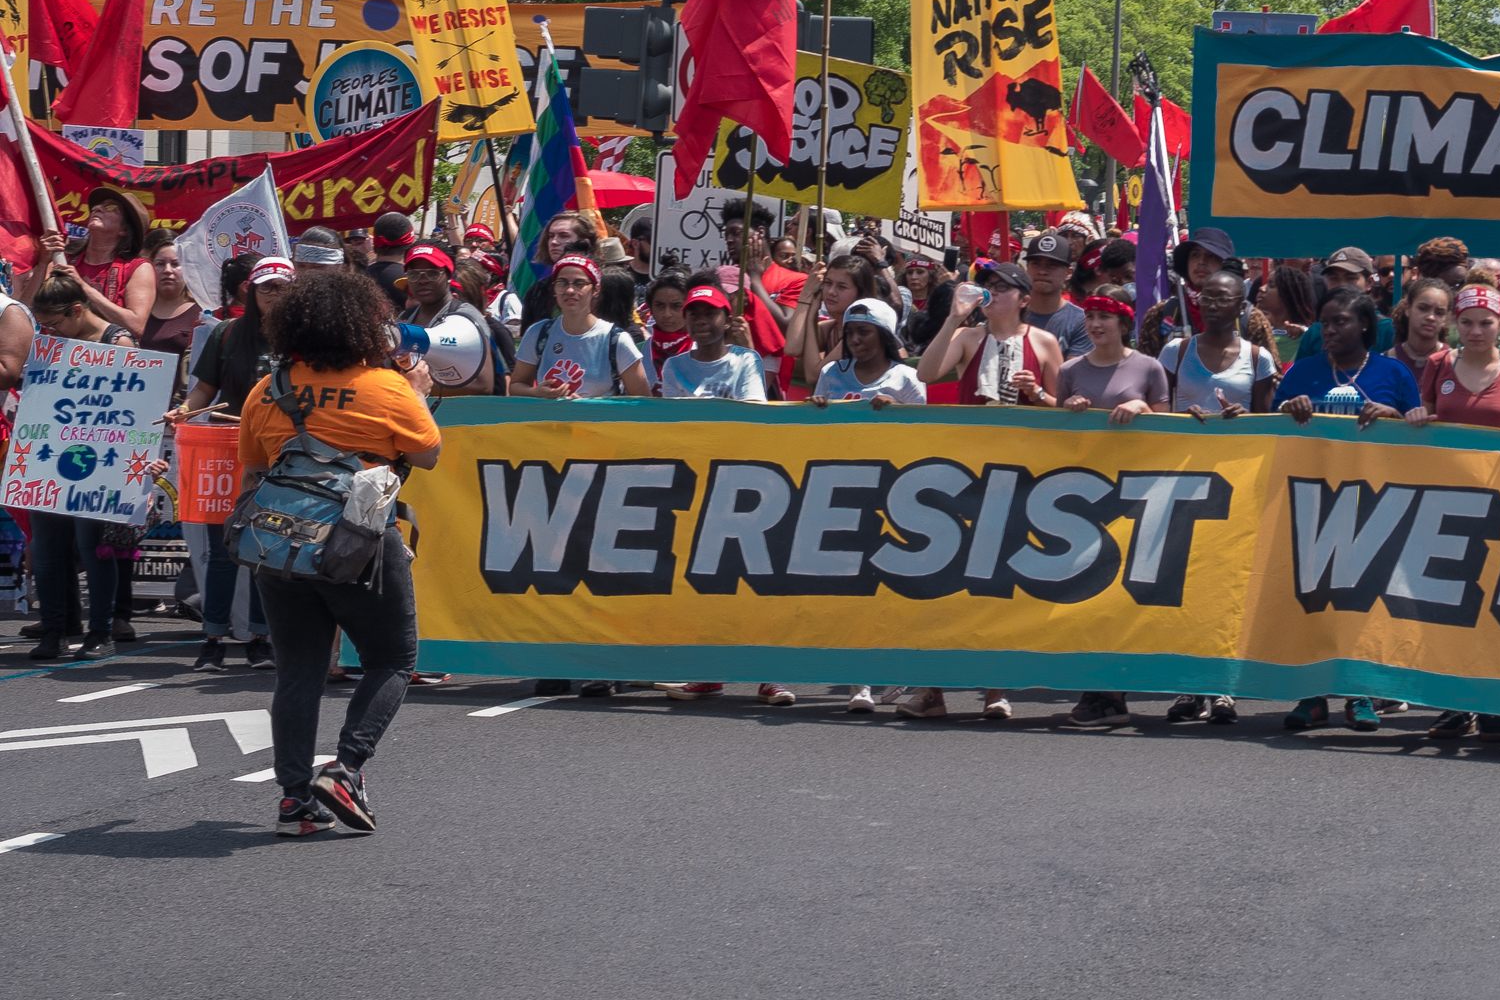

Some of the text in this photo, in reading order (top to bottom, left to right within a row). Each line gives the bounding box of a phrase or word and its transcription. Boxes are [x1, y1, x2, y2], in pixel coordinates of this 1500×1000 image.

[410, 6, 507, 34] WE RESIST
[199, 40, 288, 93] OF
[330, 68, 398, 96] PEOPLES
[433, 68, 511, 95] WE RISE
[319, 81, 415, 128] CLIMATE
[275, 138, 426, 219] cred
[894, 221, 944, 249] GROUND
[900, 210, 913, 221] EEP
[928, 219, 944, 232] THE
[35, 338, 163, 368] WE CAME From
[28, 368, 146, 392] THE Earth
[77, 394, 114, 408] AND
[261, 385, 357, 410] SAFF
[53, 398, 136, 426] STARS
[18, 423, 51, 440] OUR
[59, 425, 127, 443] CREATION
[197, 459, 234, 471] LET'S
[4, 479, 62, 509] PROTECT
[198, 474, 233, 496] DO
[196, 498, 235, 512] THIS.
[482, 463, 679, 574] WE
[692, 461, 1211, 583] RESIST
[1292, 479, 1497, 605] WE
